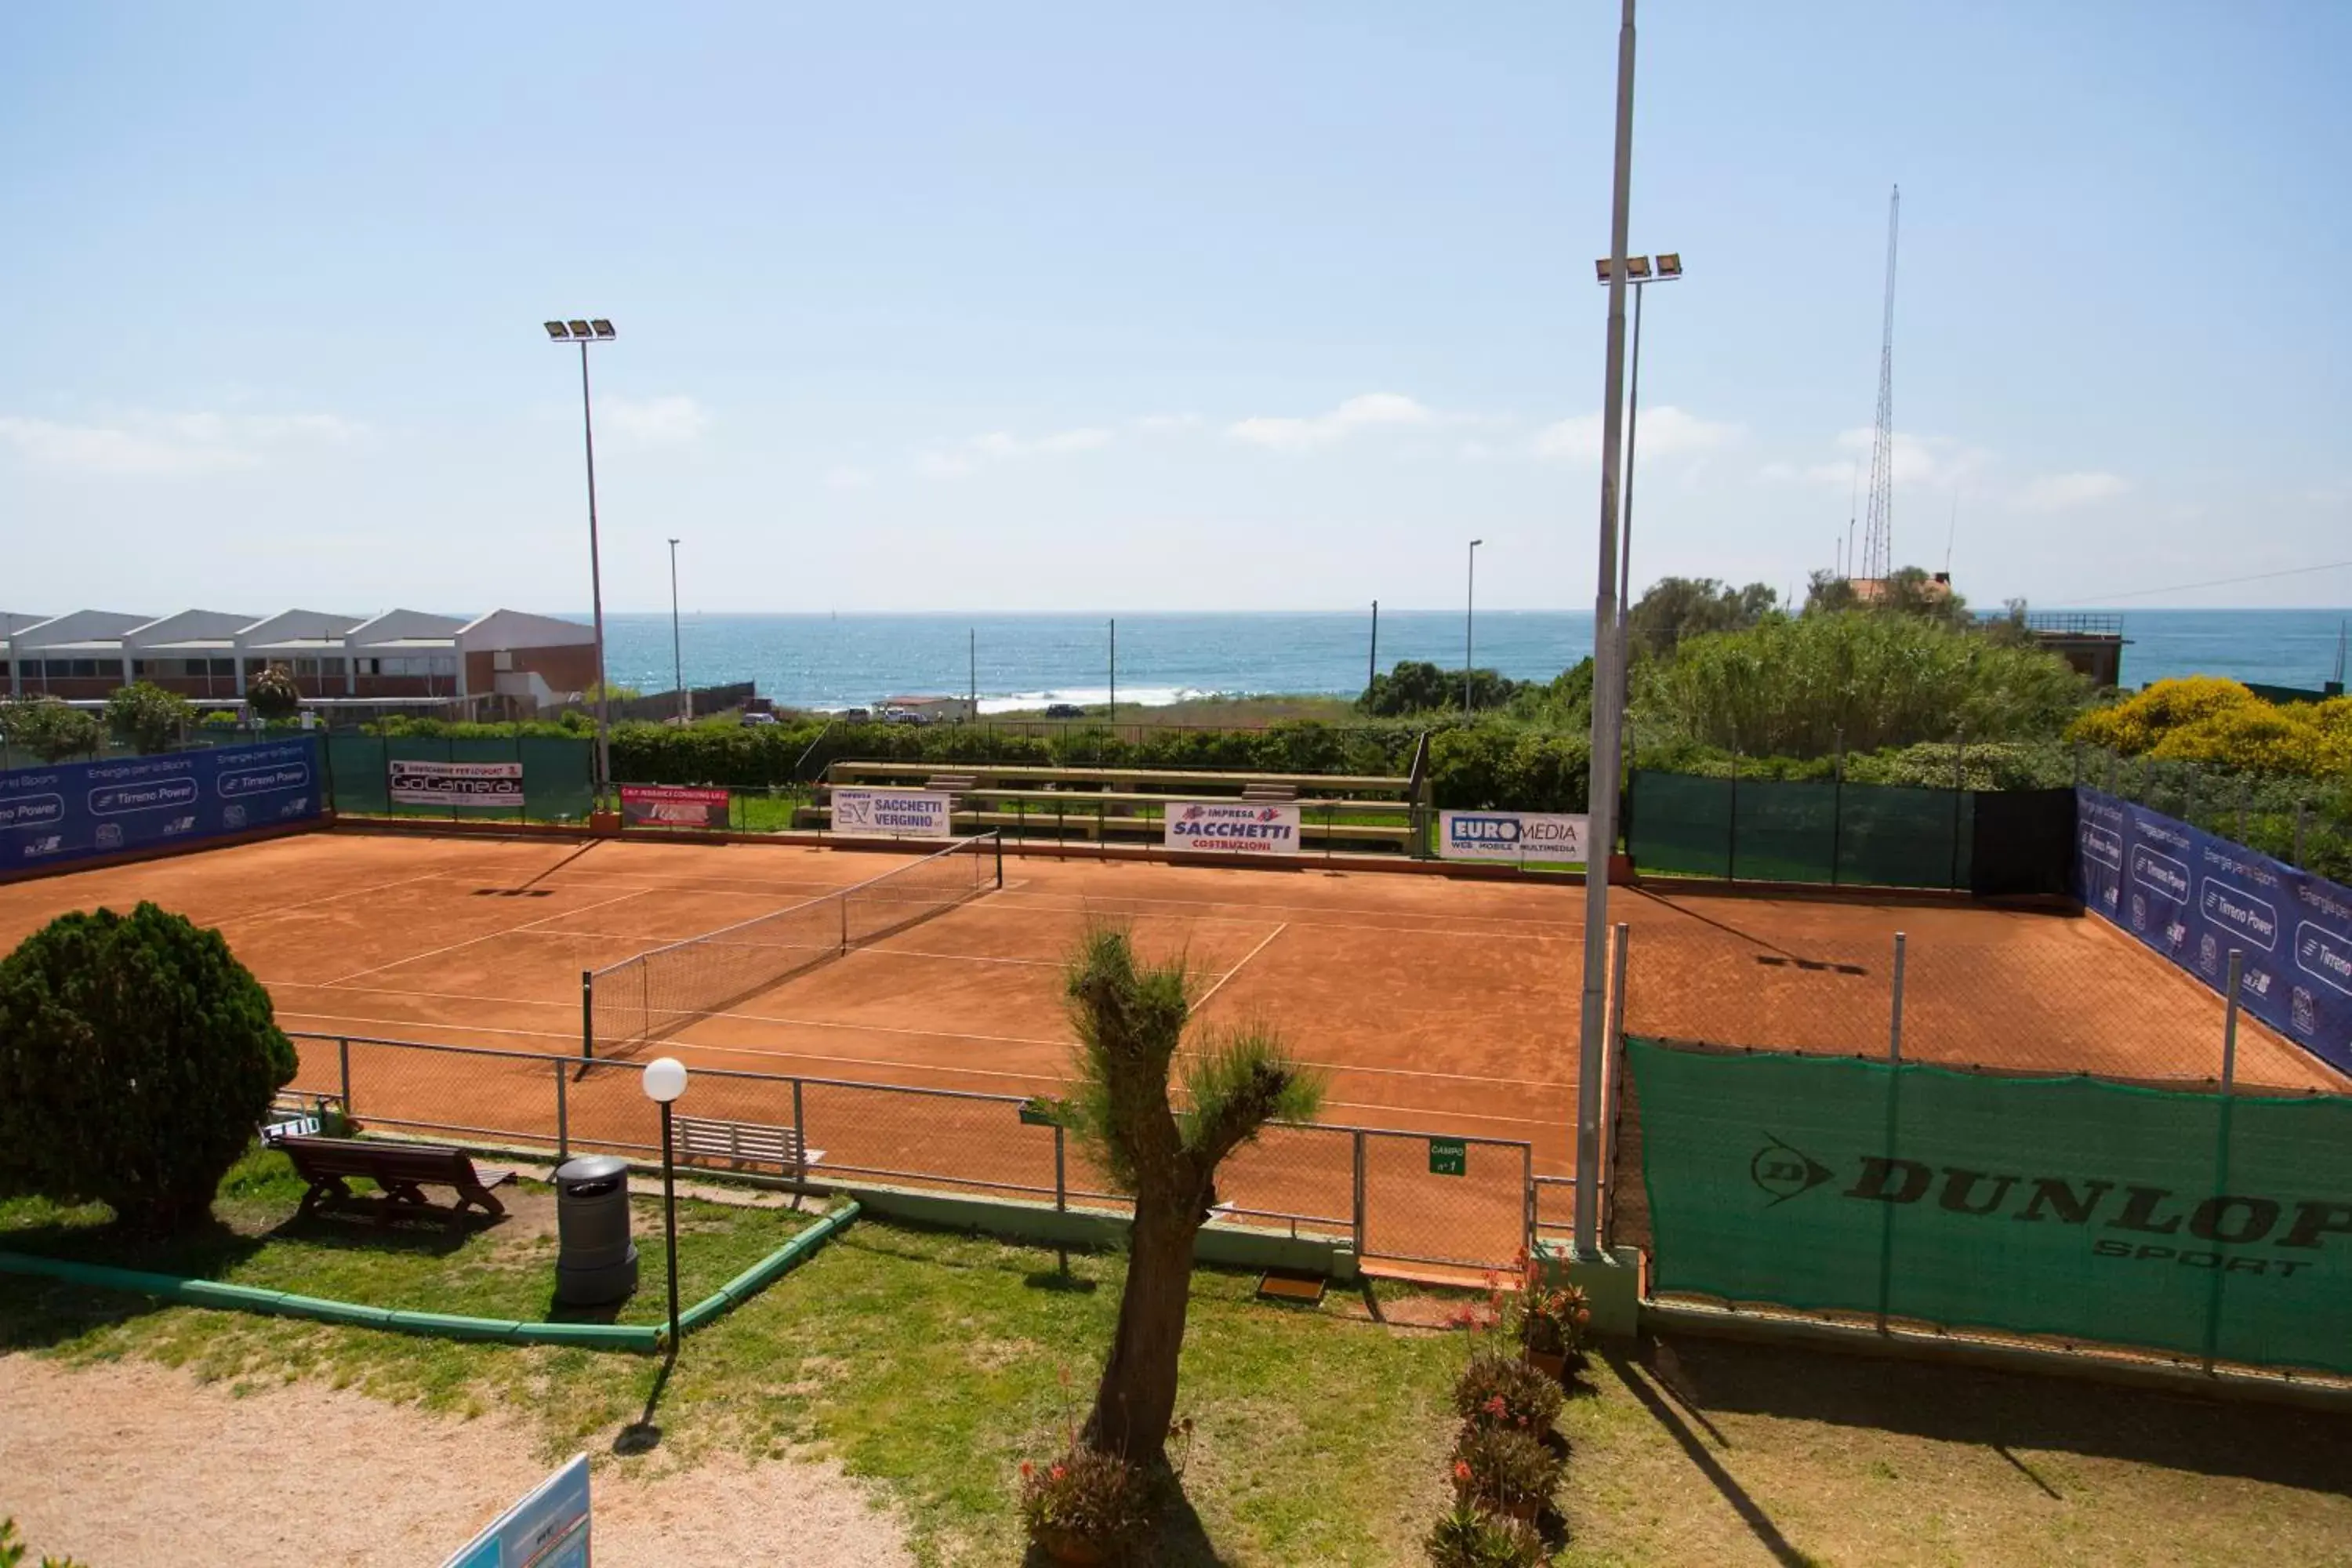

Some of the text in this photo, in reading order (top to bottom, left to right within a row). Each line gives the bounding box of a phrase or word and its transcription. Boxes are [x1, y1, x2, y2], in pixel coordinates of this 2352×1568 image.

[118, 790, 156, 804] Tirreno
[873, 798, 943, 814] SACCHETTI
[1207, 808, 1255, 818] IMPRESA
[873, 813, 933, 828] VERGINIO
[1173, 821, 1293, 840] SACCHETTI
[1192, 840, 1272, 851] COSTRUZIONI
[1451, 841, 1577, 854] WEB MOBILE MULTIMEDIA
[2219, 895, 2274, 936] Tirreno Power
[1431, 1145, 1465, 1157] CAMPO
[1842, 1155, 2352, 1250] DUNLOP
[2092, 1238, 2314, 1279] SPORT
